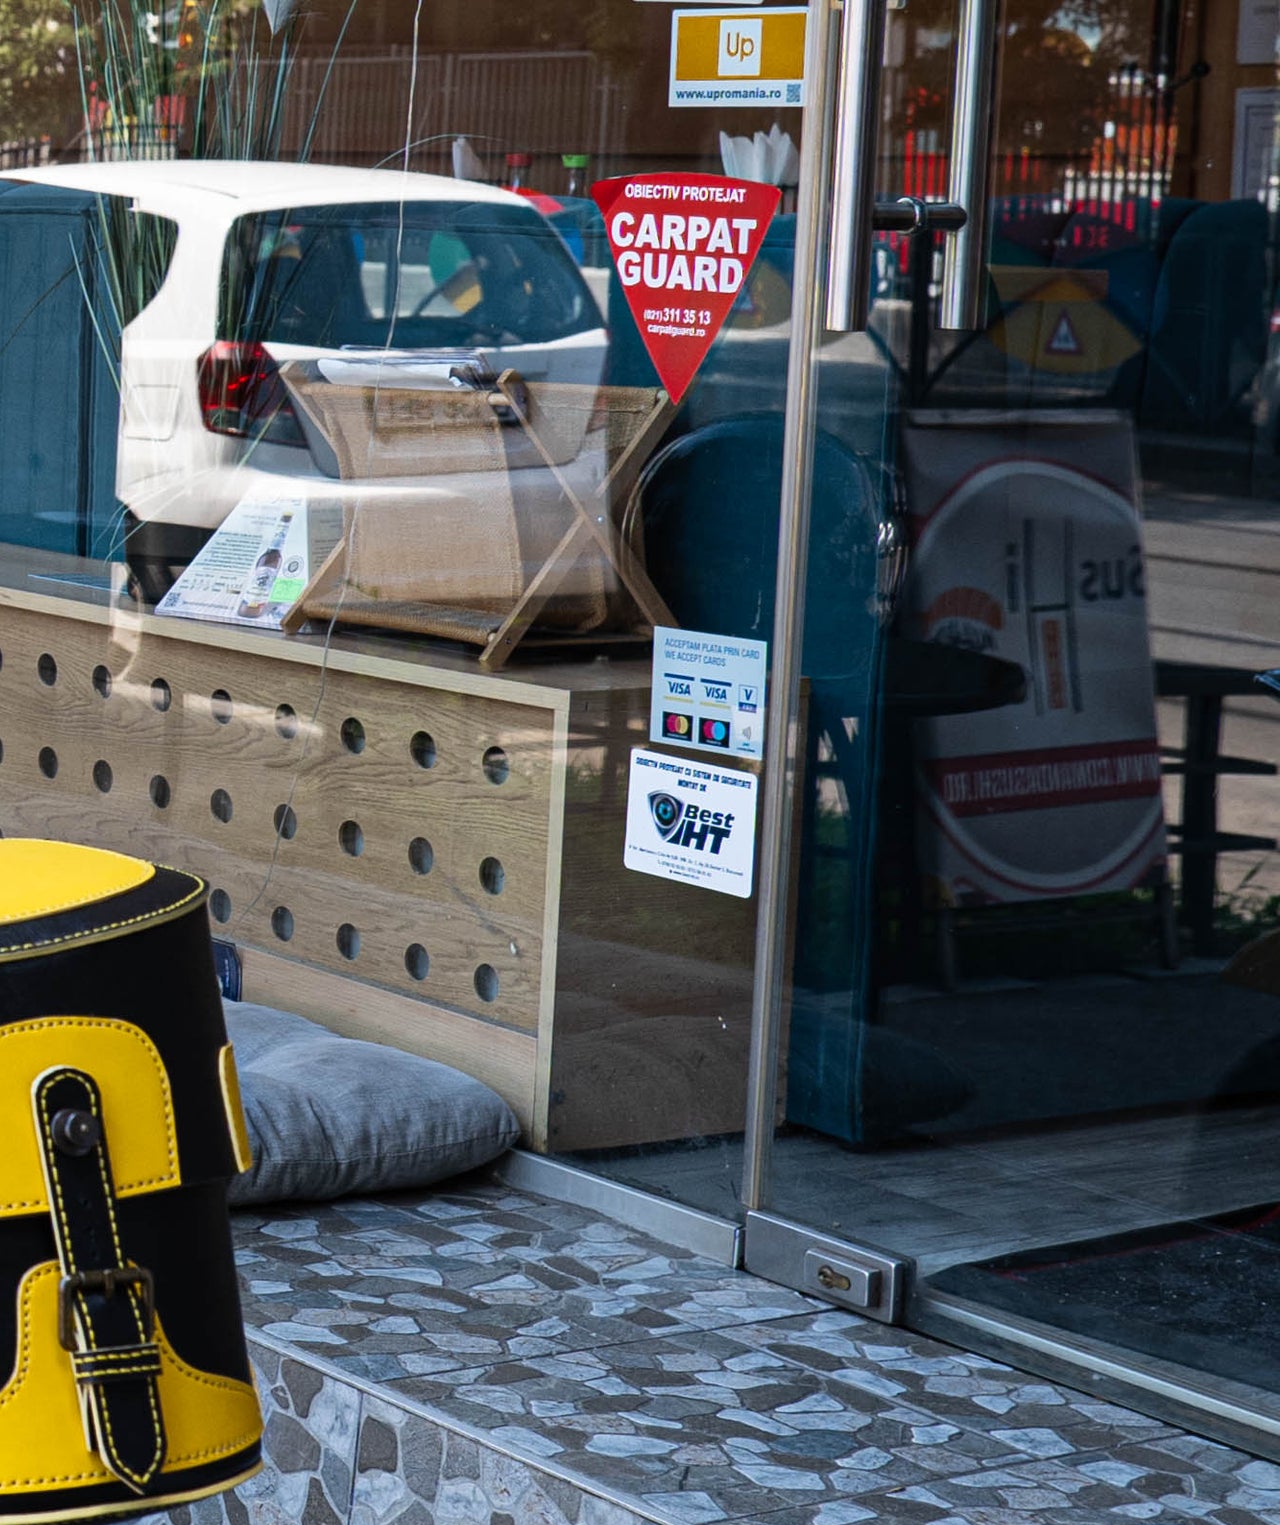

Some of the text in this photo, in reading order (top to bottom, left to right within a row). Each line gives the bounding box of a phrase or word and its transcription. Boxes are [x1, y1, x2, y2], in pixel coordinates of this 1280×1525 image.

[726, 32, 755, 62] Up
[675, 87, 782, 102] www.upromania.ro
[624, 183, 747, 204] OBIECTIV PROTEJAT
[611, 211, 758, 255] CARPAT
[616, 250, 744, 294] GUARD
[662, 308, 681, 323] 311
[682, 308, 696, 324] 35
[698, 310, 711, 325] 13
[647, 323, 706, 337] carpatguard.ro
[702, 642, 723, 654] PLATA
[677, 651, 702, 663] ACCEPT
[703, 655, 726, 667] CARDS
[668, 681, 692, 696] VISA
[704, 685, 728, 700] VISA
[684, 803, 735, 829] Best
[680, 819, 732, 855] HT
